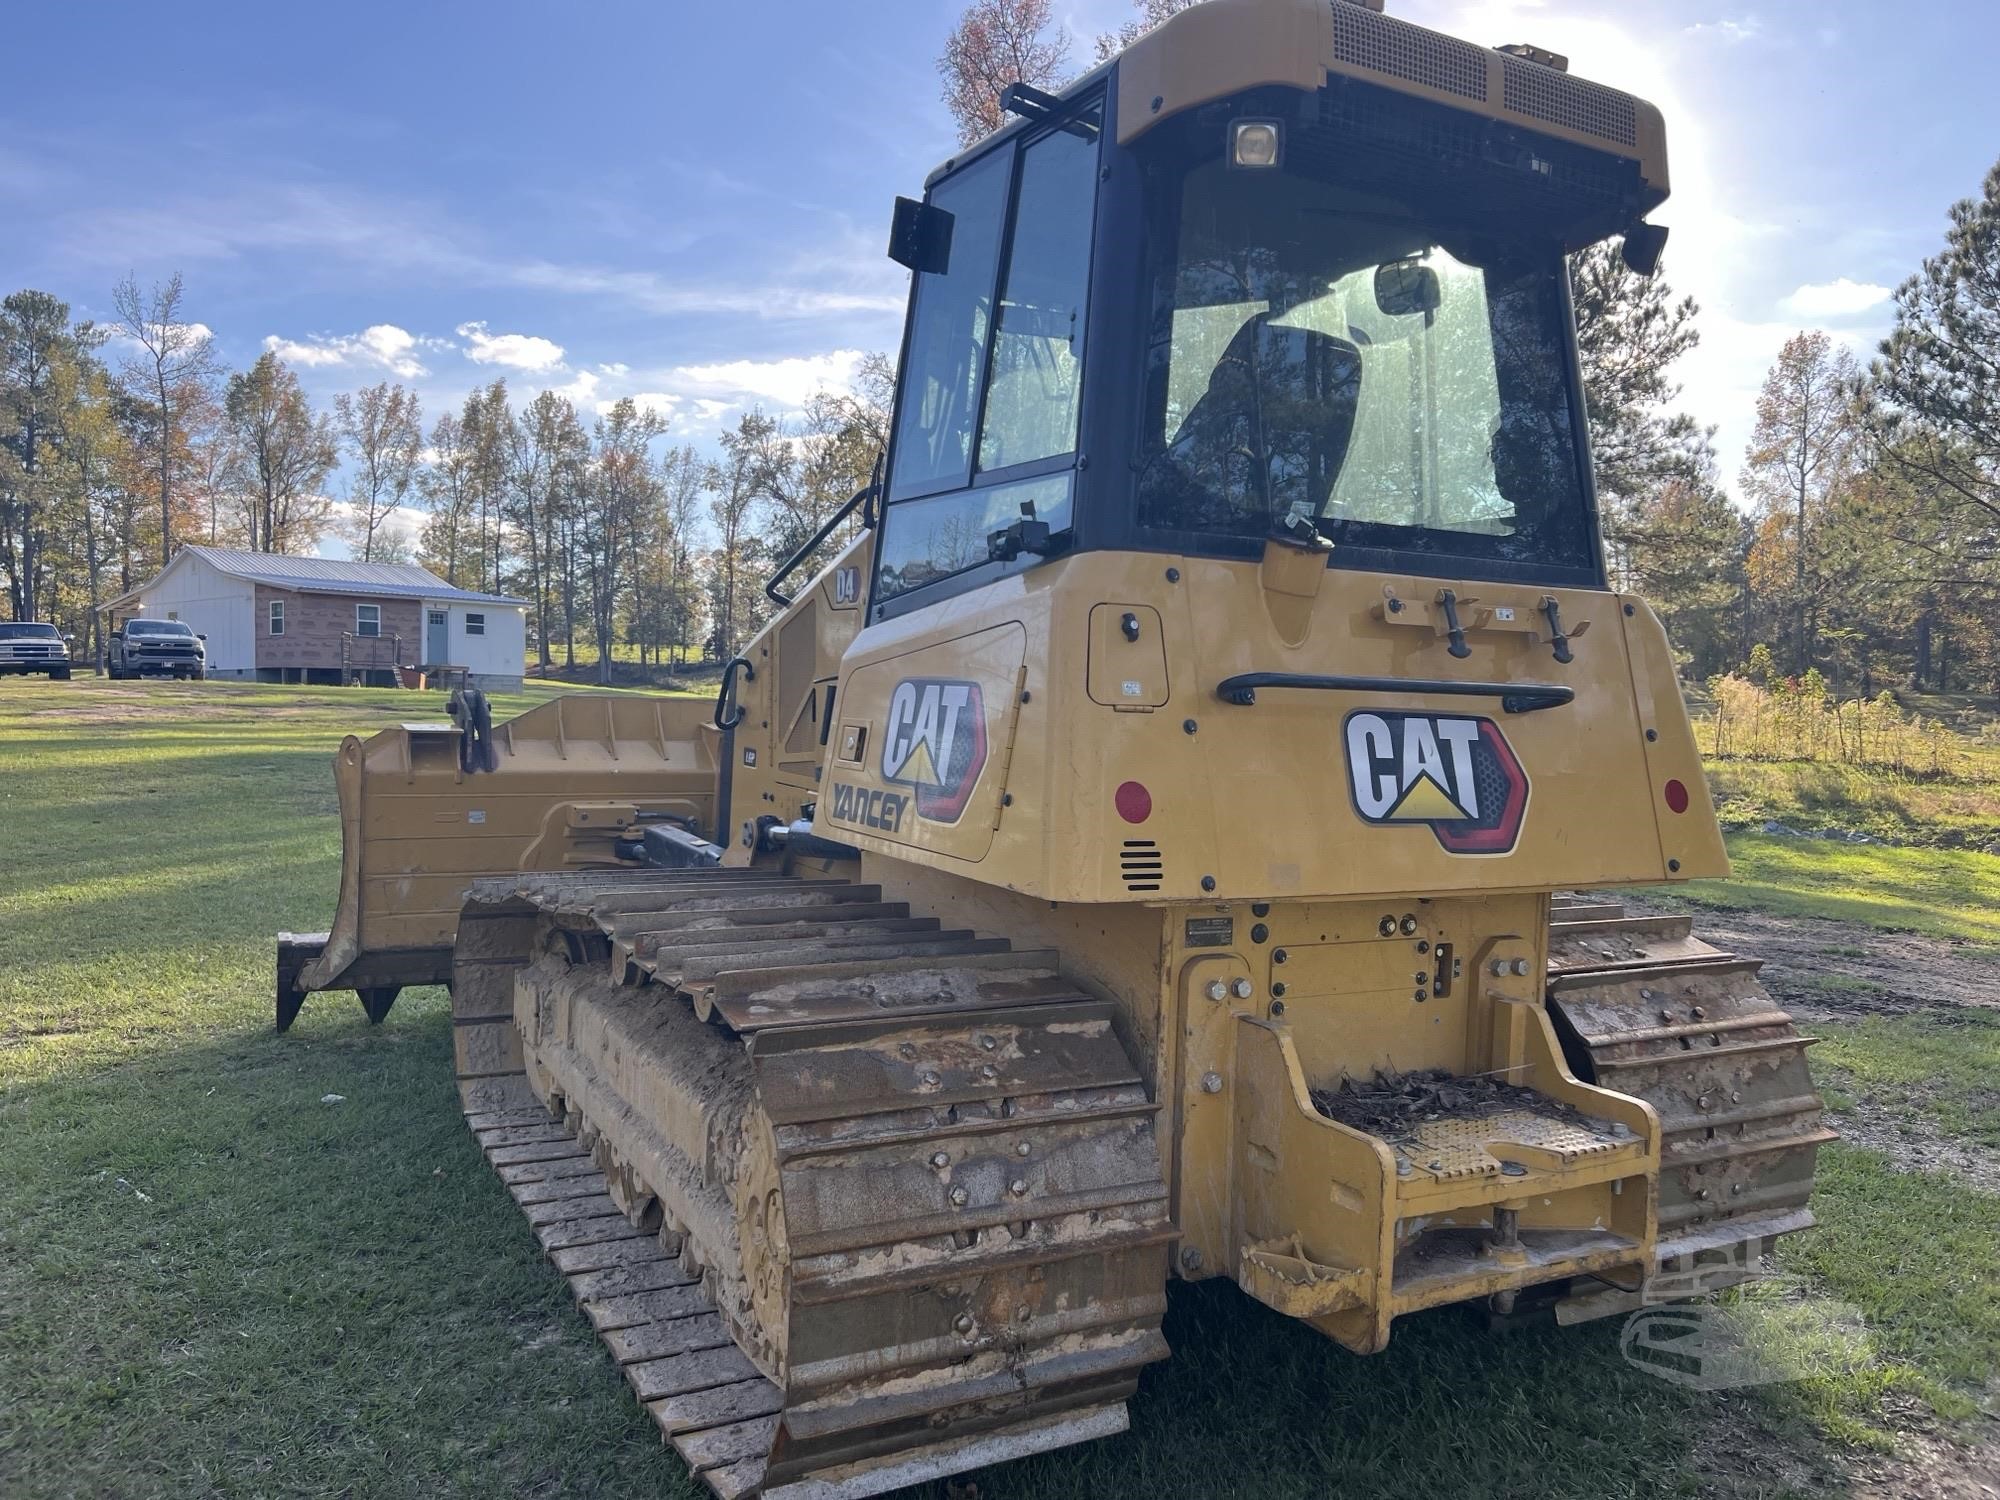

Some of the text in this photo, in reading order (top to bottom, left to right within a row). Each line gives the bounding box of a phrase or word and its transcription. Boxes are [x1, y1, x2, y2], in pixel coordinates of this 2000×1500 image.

[836, 568, 854, 602] D4
[882, 682, 970, 786] CAT
[1346, 713, 1480, 819] CAT
[833, 782, 910, 833] YANCEY
